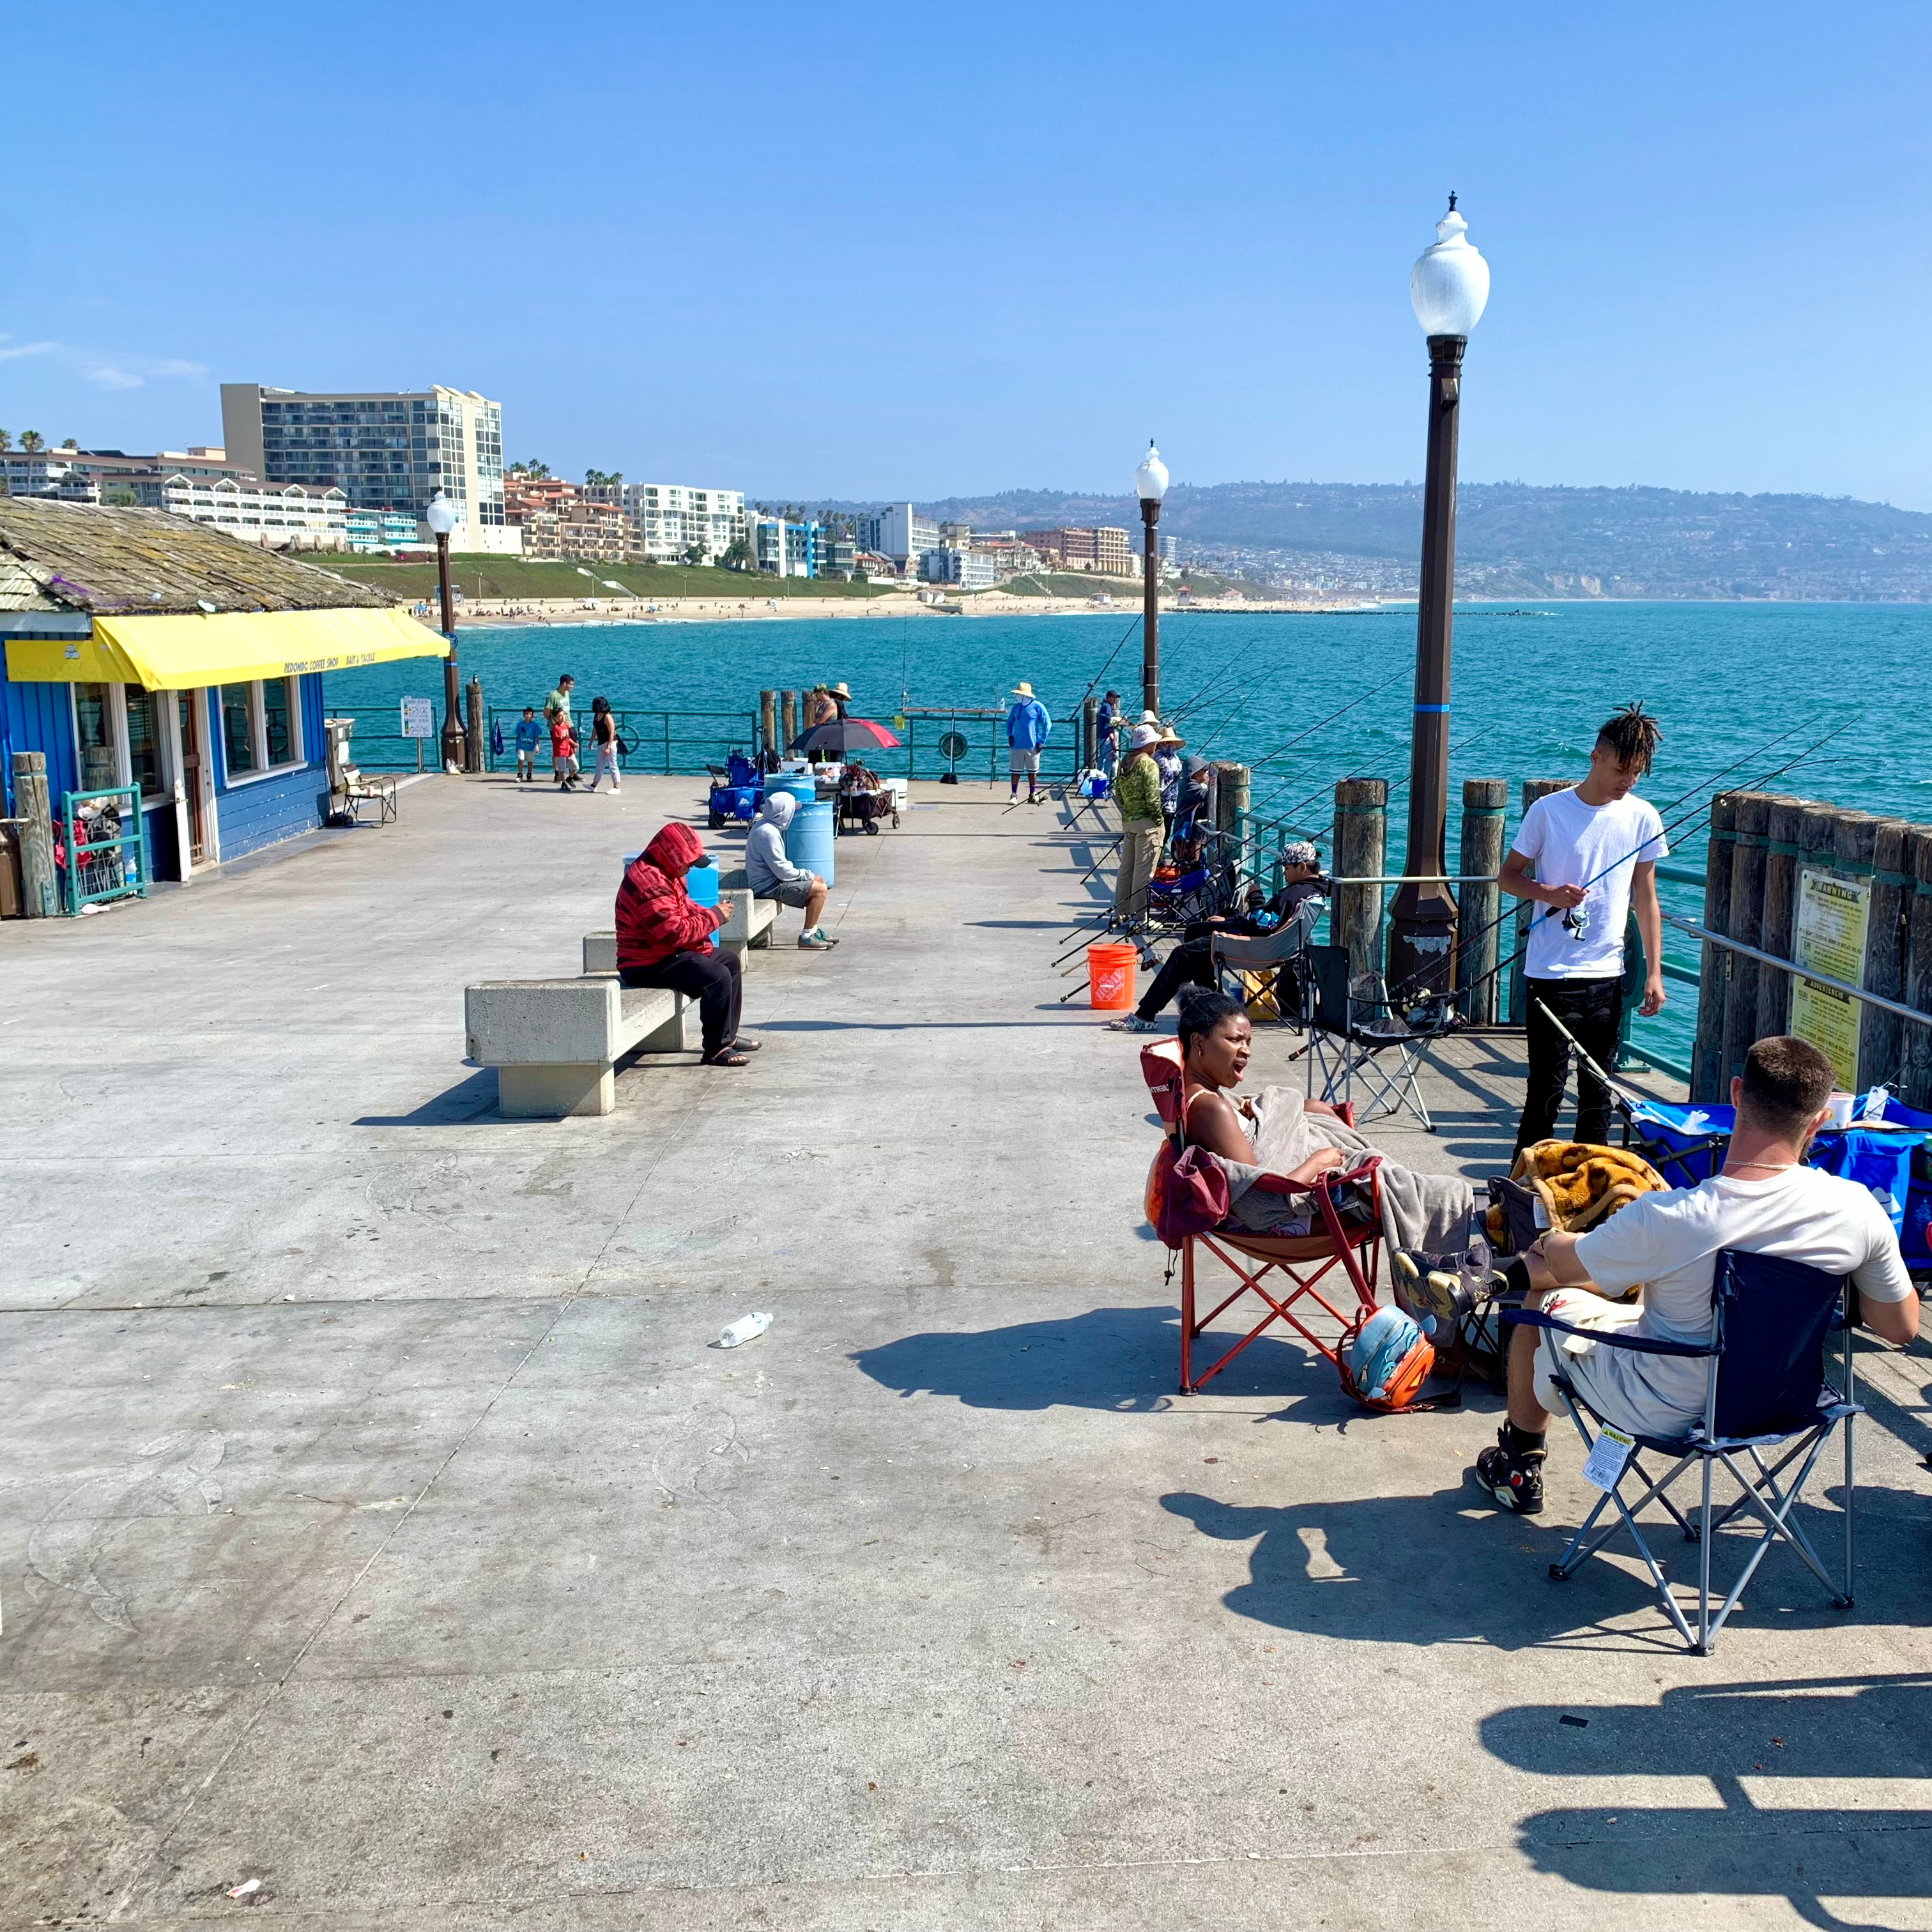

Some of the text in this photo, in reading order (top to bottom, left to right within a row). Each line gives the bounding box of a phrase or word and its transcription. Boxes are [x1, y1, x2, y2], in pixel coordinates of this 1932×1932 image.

[309, 659, 326, 671] COFFEE
[326, 657, 339, 668] SHOP
[346, 655, 356, 665] BAIT
[360, 652, 376, 664] TACKLE
[1815, 882, 1852, 900] WARNING
